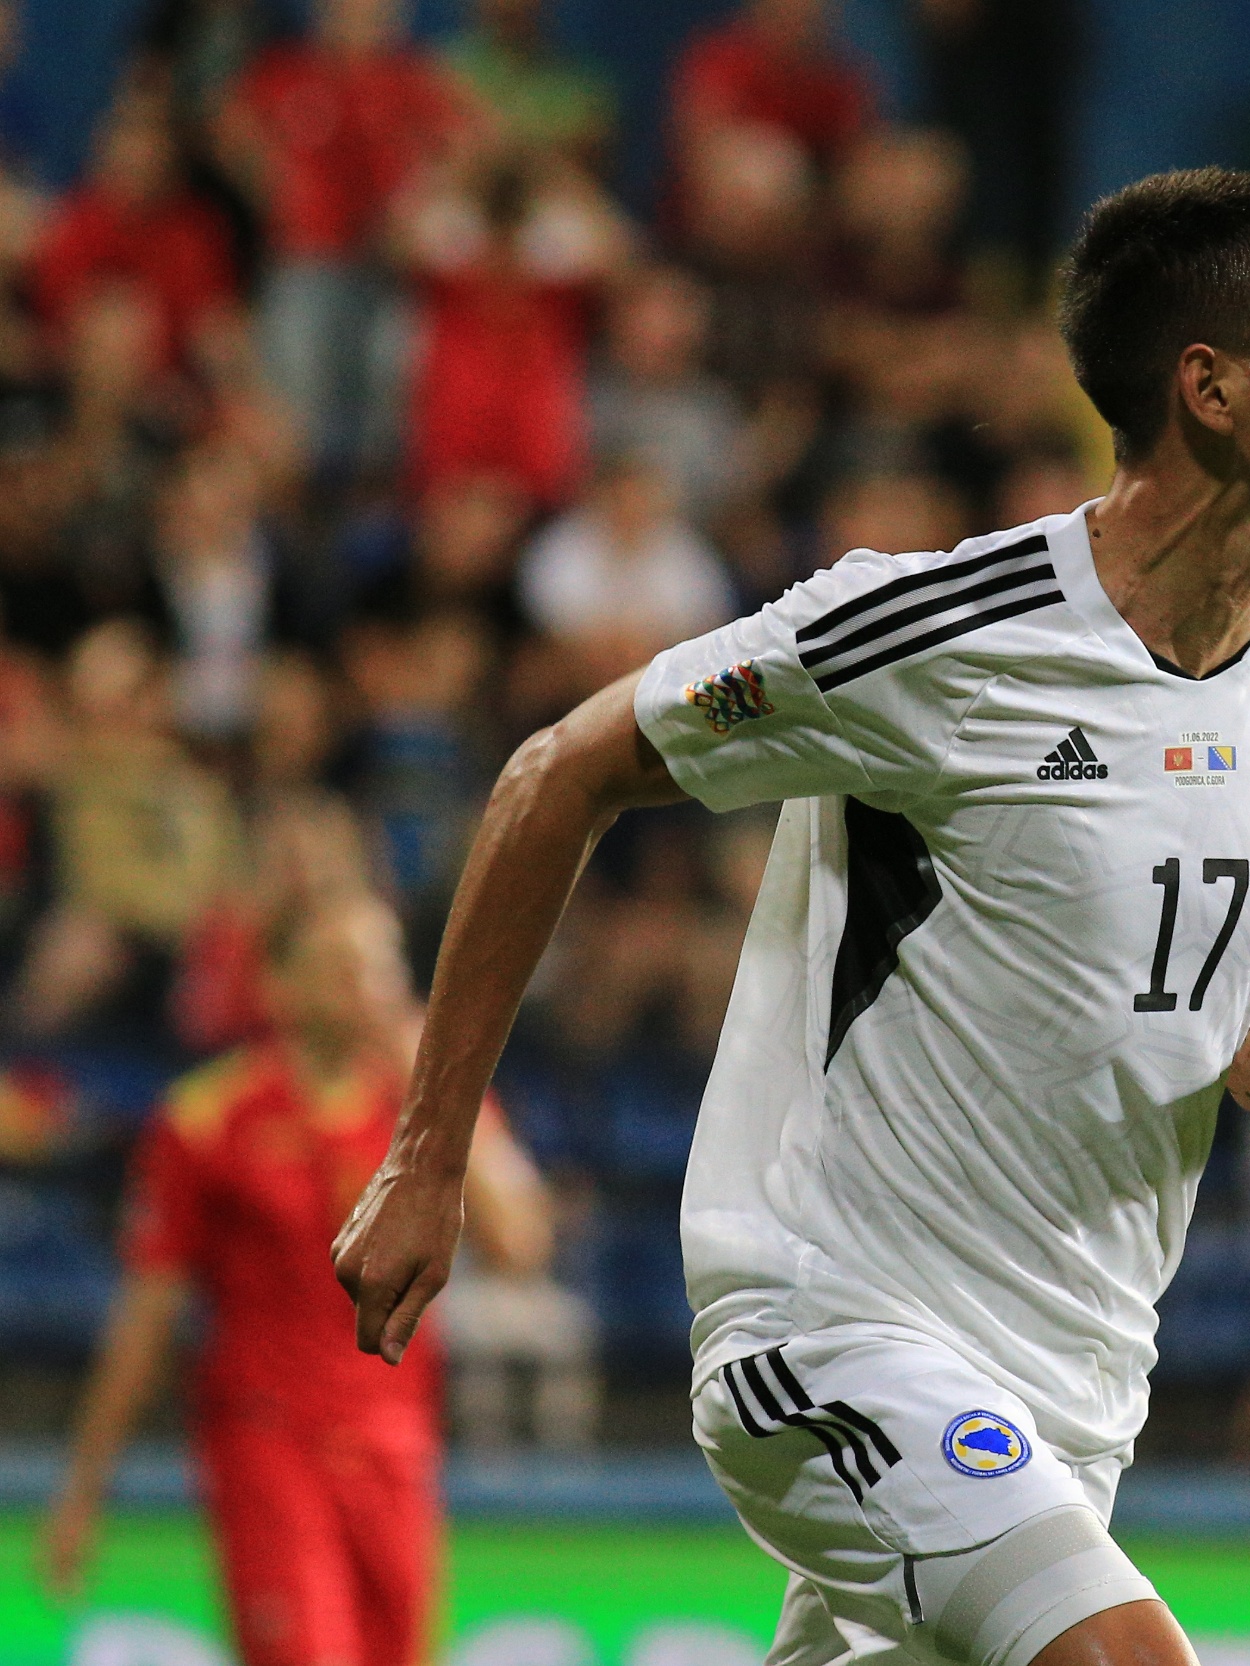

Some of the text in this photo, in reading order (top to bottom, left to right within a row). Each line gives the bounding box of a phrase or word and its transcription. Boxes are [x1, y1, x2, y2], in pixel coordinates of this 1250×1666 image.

[1181, 732, 1219, 742] 11.06.2022
[1037, 760, 1108, 781] adidas
[1133, 857, 1250, 1013] 17
